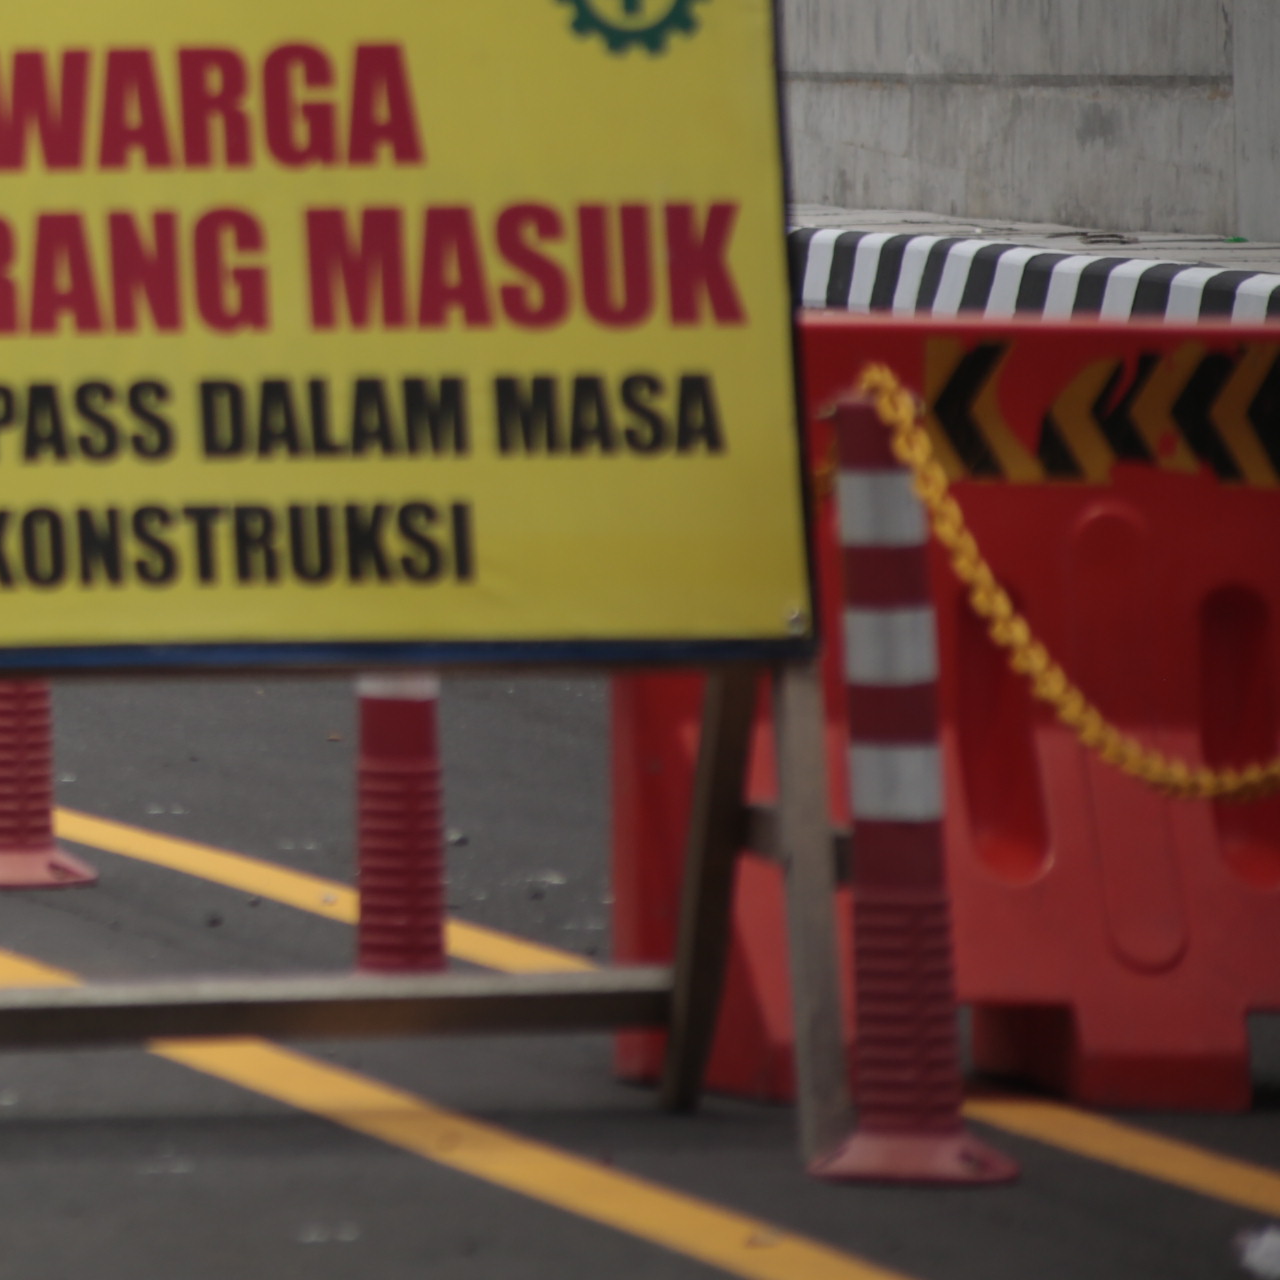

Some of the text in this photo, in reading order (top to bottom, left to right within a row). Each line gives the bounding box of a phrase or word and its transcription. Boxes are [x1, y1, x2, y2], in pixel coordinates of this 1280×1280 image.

[303, 201, 747, 330] MASUK
[198, 375, 470, 460] DALAM
[492, 371, 726, 458] MASA
